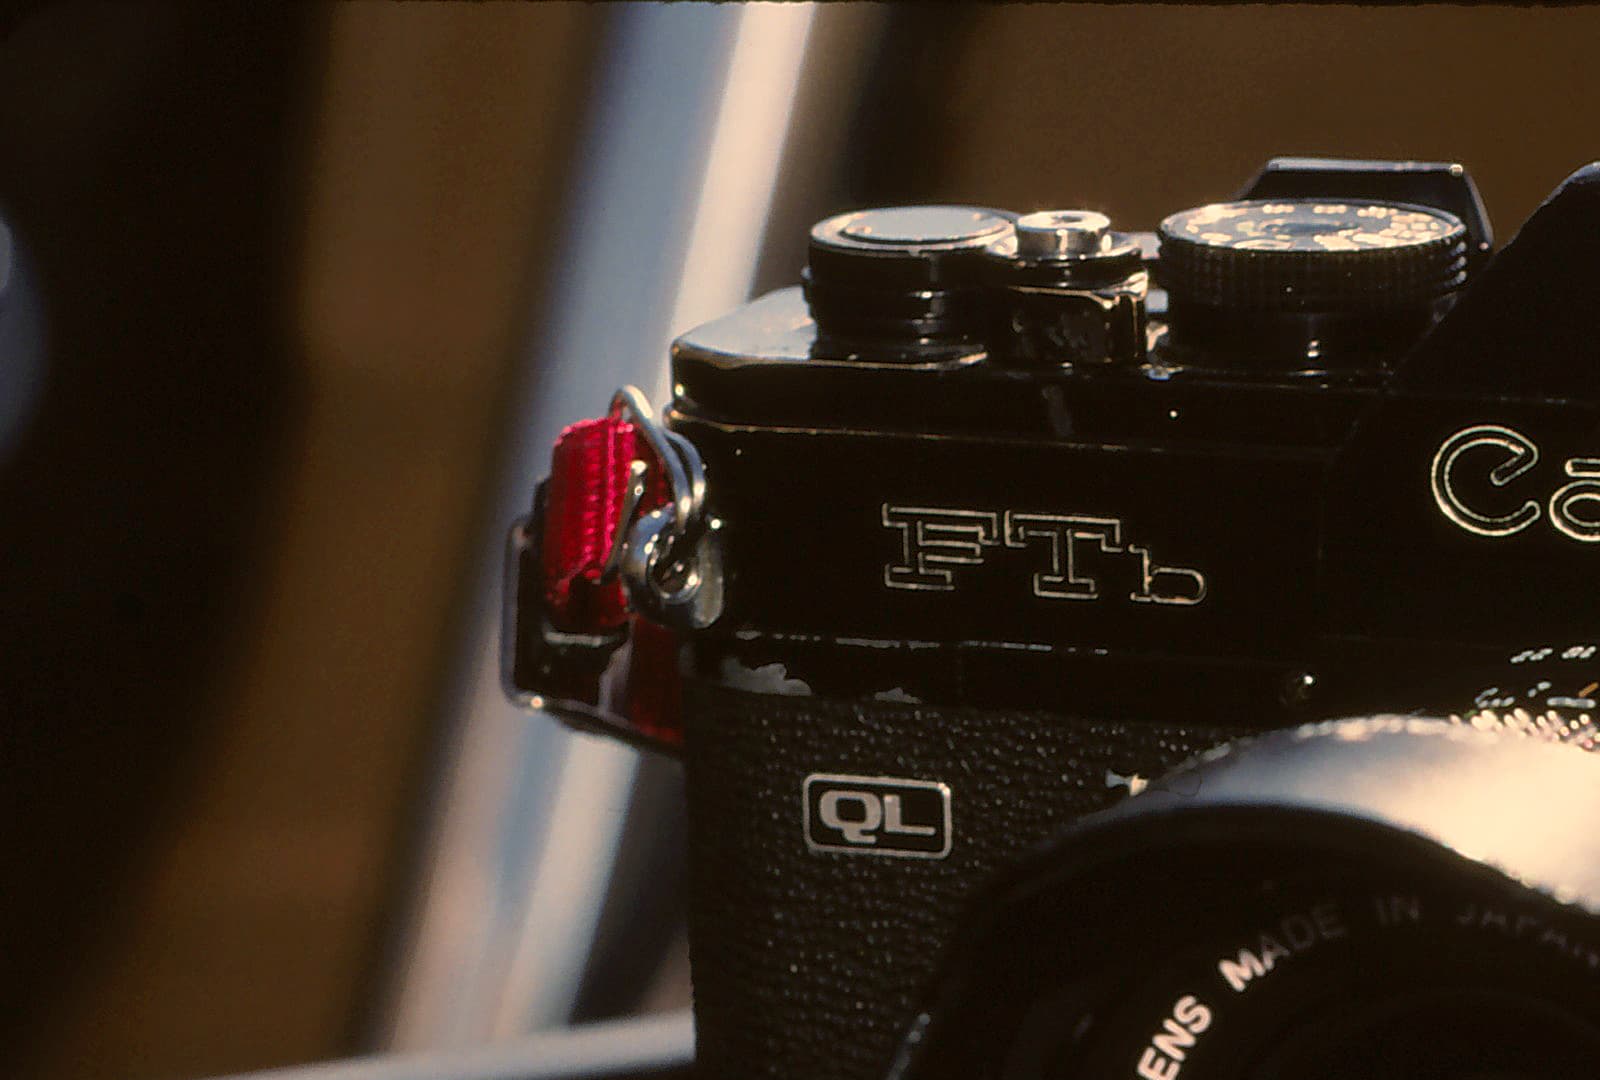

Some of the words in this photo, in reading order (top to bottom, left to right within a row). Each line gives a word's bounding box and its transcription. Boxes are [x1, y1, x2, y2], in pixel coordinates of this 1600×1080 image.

[881, 503, 1207, 606] FTb
[818, 789, 937, 845] QL
[1217, 901, 1348, 992] MADE
